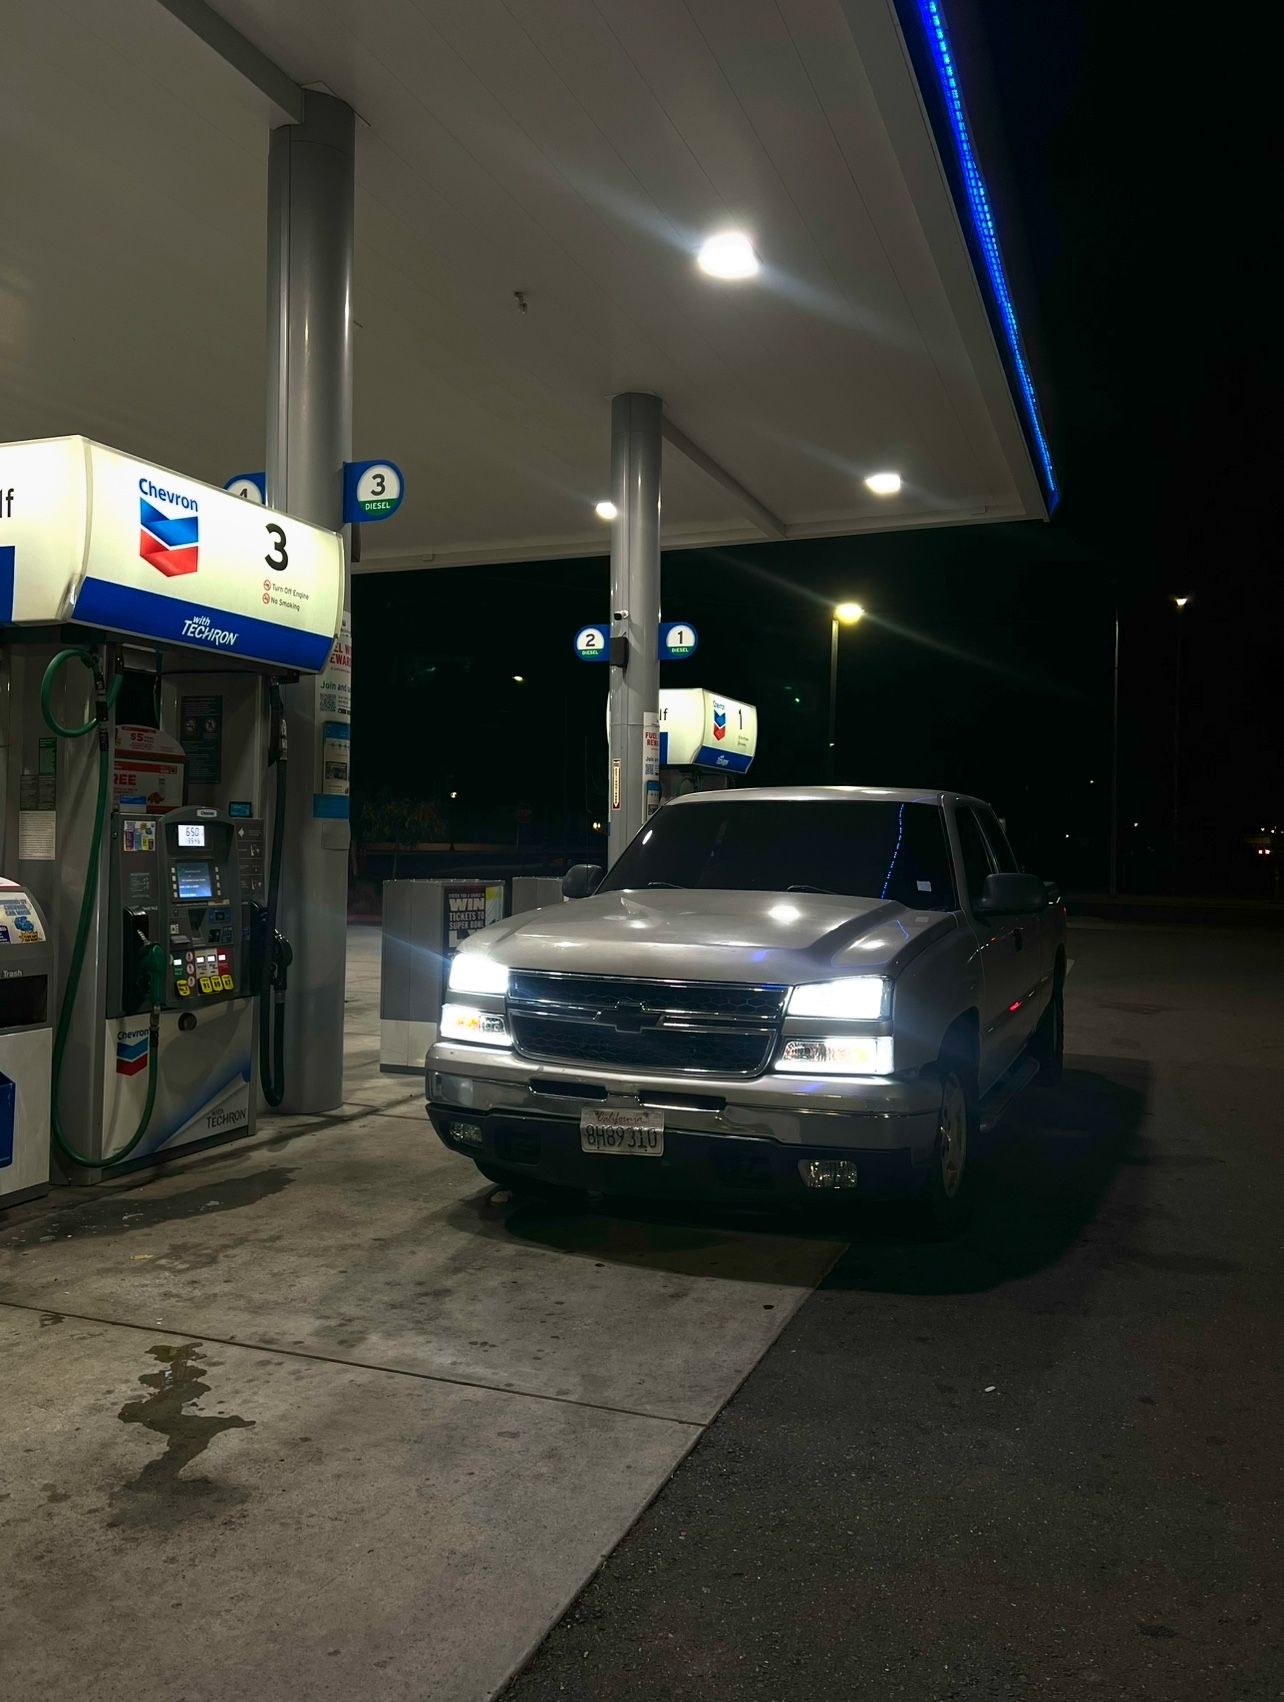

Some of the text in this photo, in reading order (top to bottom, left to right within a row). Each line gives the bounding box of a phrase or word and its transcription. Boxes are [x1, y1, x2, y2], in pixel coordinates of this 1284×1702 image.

[371, 473, 386, 496] 3
[139, 479, 198, 512] Chevron
[365, 502, 391, 511] DIESEL
[264, 523, 289, 571] 3
[272, 583, 310, 601] Turn Off Engine
[271, 596, 300, 612] No Smoking
[193, 616, 211, 627] with
[181, 619, 237, 646] TECHRON
[586, 633, 595, 647] 2
[678, 631, 683, 644] 1
[320, 681, 336, 690] Join
[739, 709, 743, 730] 1
[449, 897, 485, 912] WIN
[449, 912, 477, 922] TICKETS
[449, 921, 469, 930] SUPER
[117, 1029, 149, 1040] Chevron
[207, 1108, 247, 1128] TECHRON
